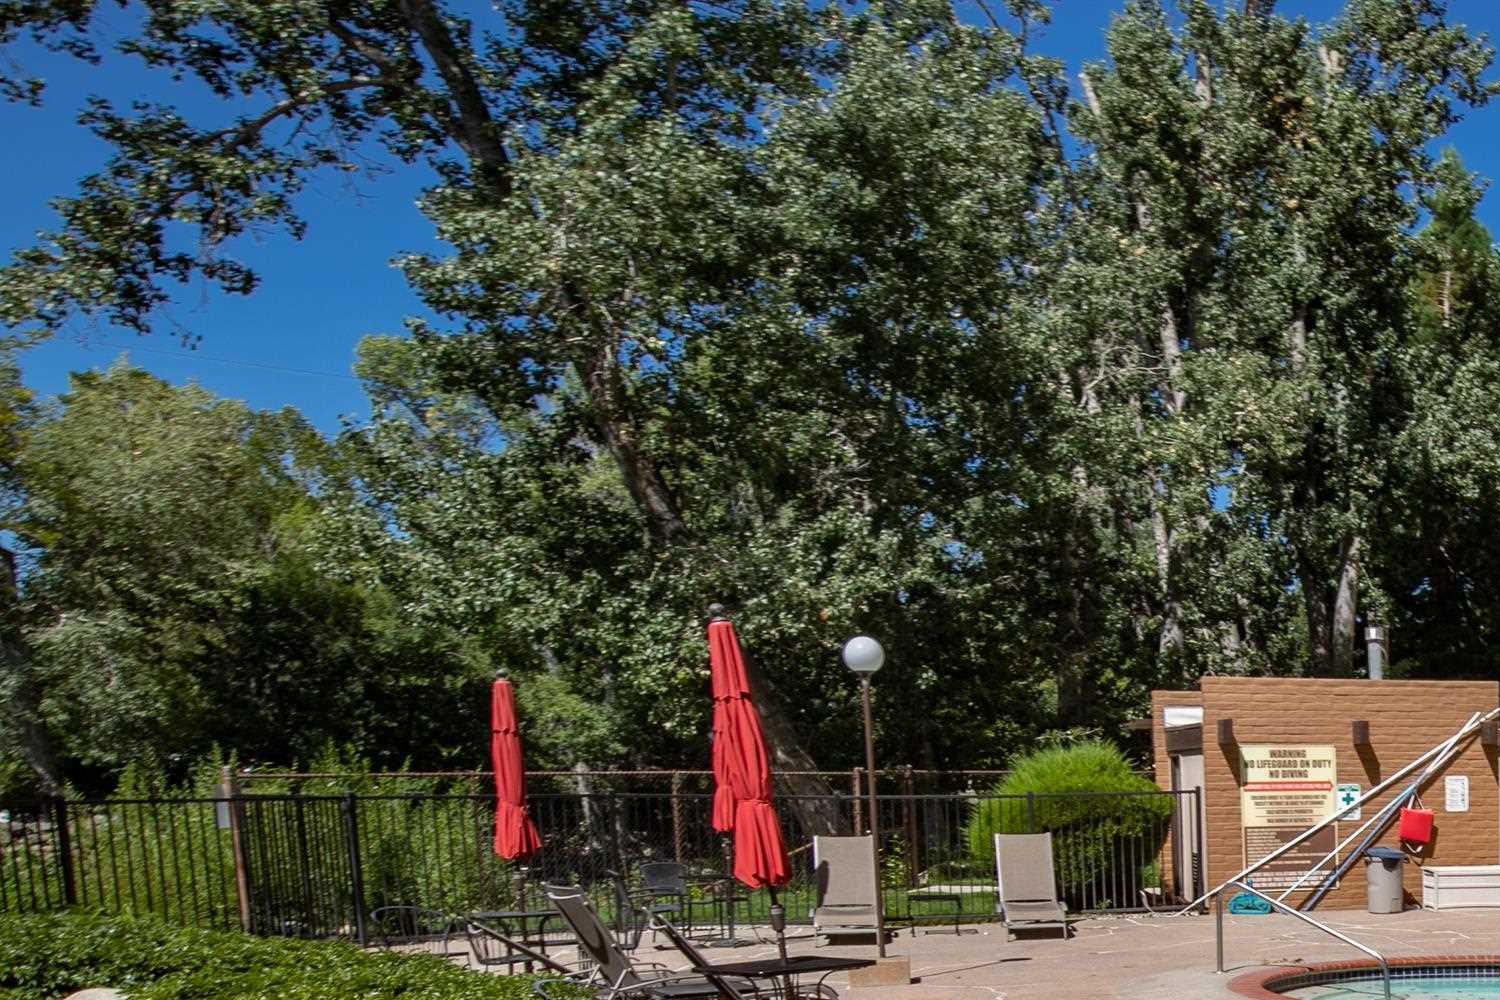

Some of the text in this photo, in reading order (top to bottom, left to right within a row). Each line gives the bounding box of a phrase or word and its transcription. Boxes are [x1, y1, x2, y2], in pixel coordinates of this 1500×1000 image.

[1269, 749, 1307, 758] WARNING
[1257, 759, 1298, 768] LIFEGUARD
[1300, 759, 1311, 768] ON
[1312, 759, 1332, 768] DUTY
[1268, 769, 1309, 778] NO DIVING
